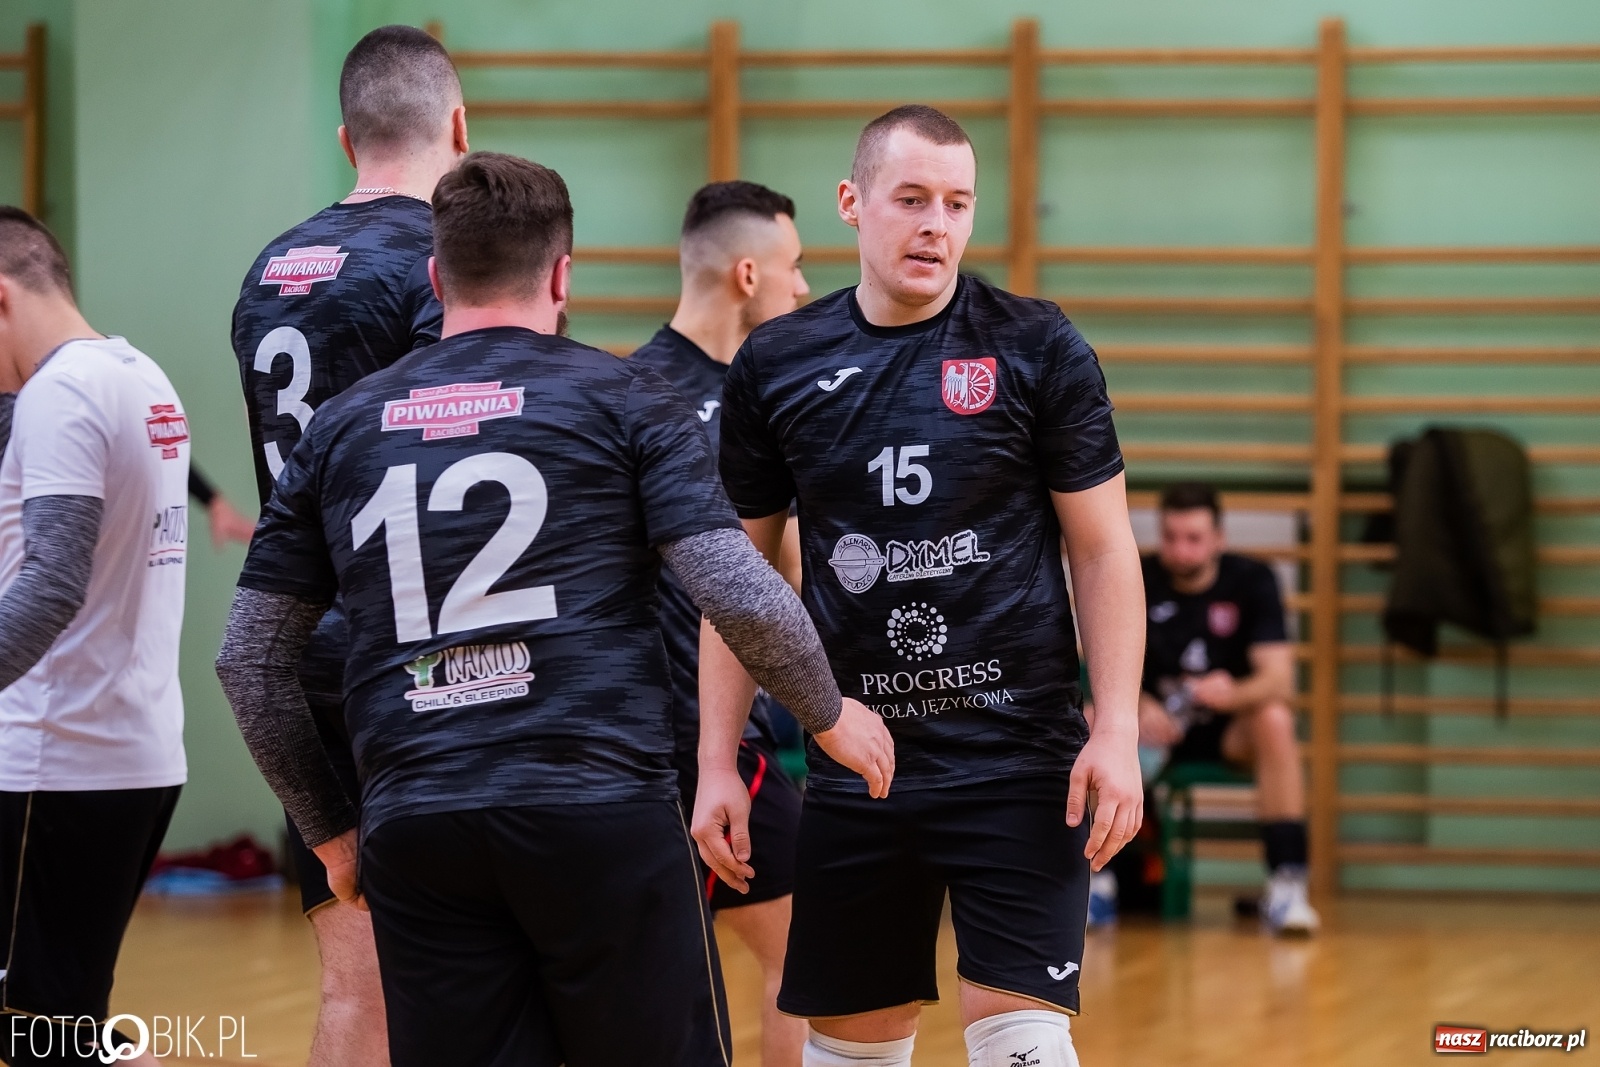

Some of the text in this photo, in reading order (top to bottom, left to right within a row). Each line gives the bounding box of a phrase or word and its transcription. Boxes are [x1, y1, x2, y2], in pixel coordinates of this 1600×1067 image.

[267, 259, 337, 278] PIWIARNIA
[253, 326, 316, 481] 3
[392, 395, 512, 423] PIWIARNIA
[867, 444, 933, 507] 15
[351, 451, 558, 644] 12
[837, 537, 873, 553] CULINARY
[887, 530, 990, 572] DYMEL
[841, 574, 873, 590] STUDIO
[888, 573, 914, 581] CATERING
[860, 659, 1002, 695] PROGRESS
[415, 685, 526, 709] CHILL & SLEEPING
[865, 688, 1014, 719] KOŁA JĘZYKOWA
